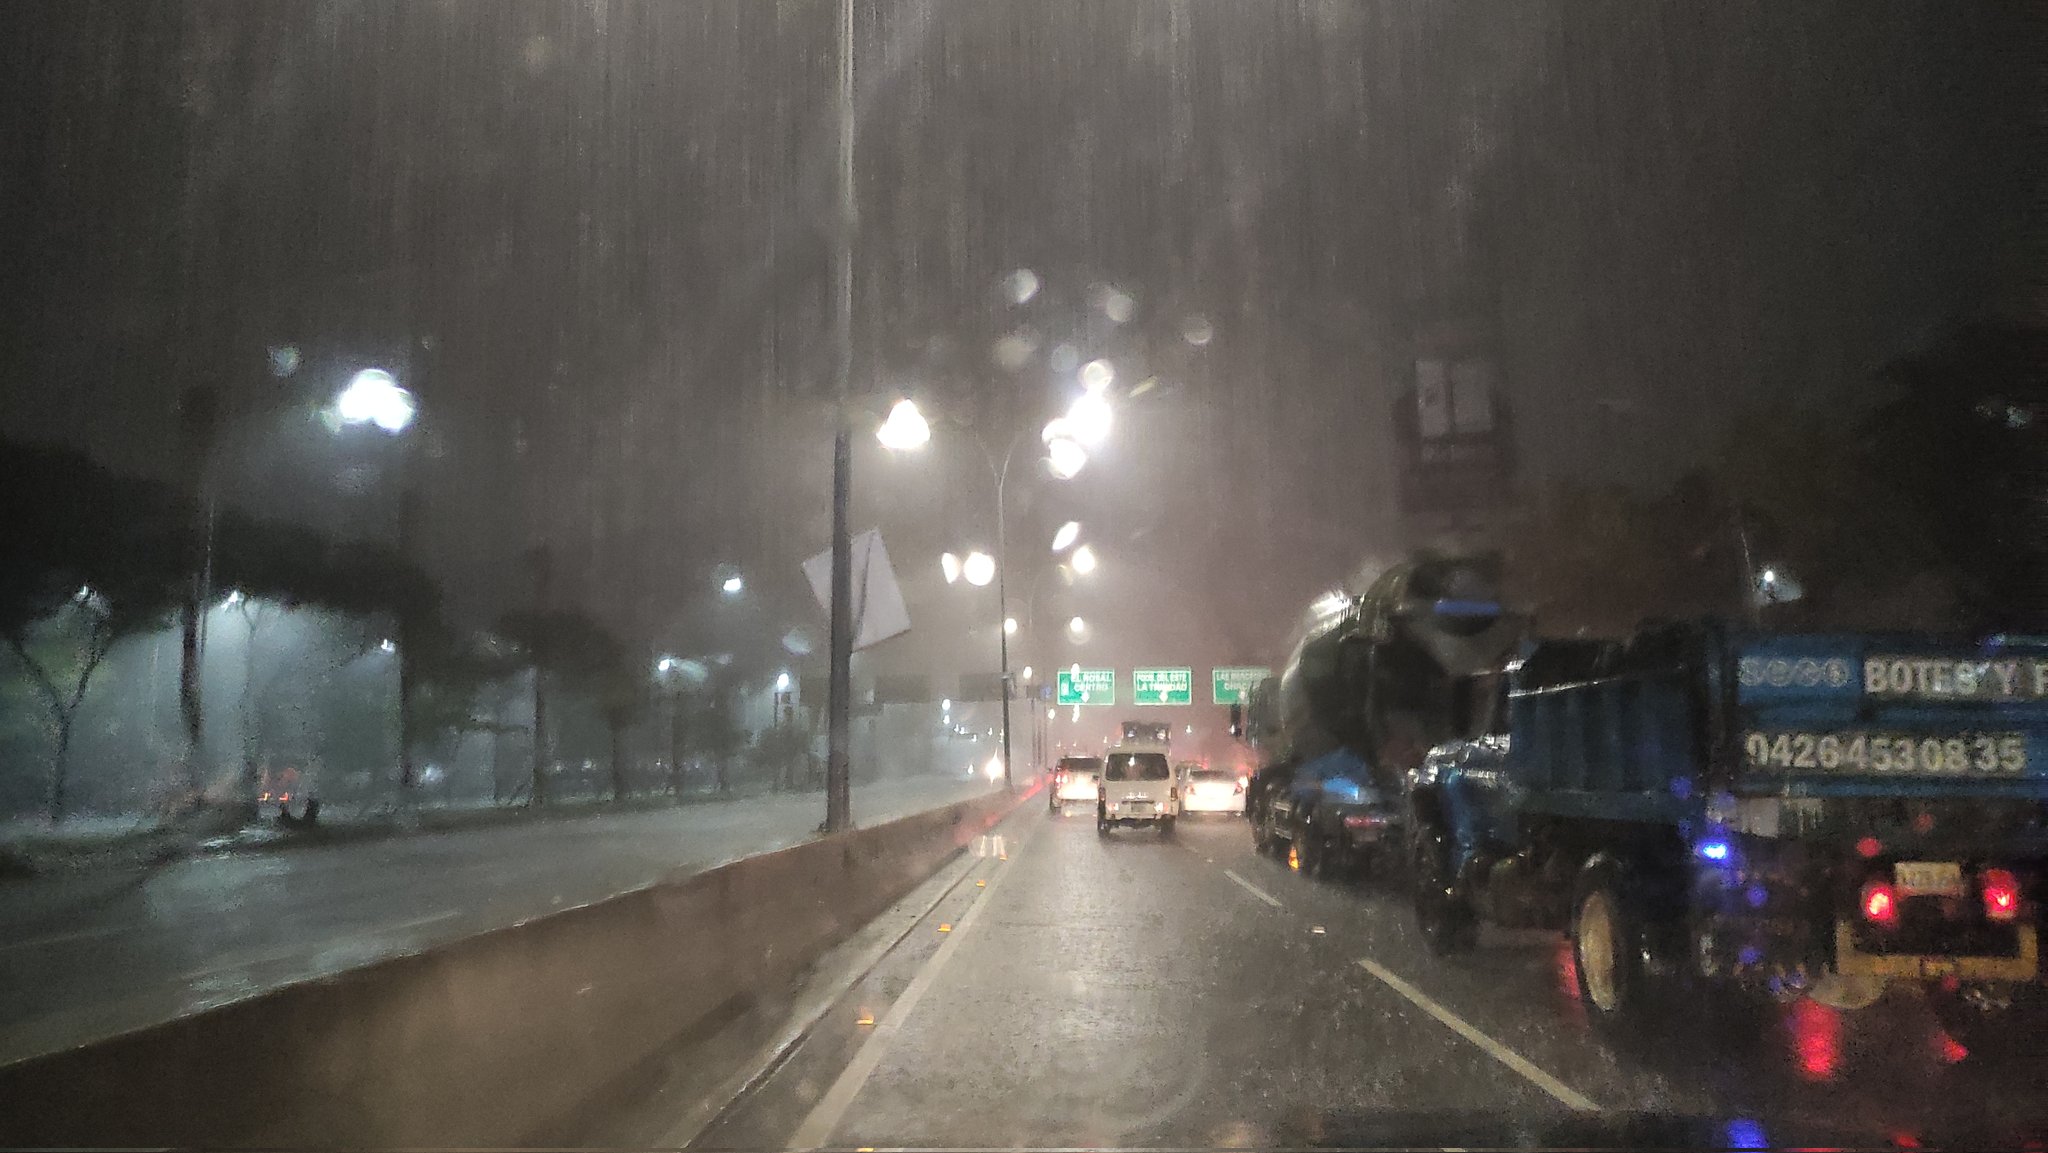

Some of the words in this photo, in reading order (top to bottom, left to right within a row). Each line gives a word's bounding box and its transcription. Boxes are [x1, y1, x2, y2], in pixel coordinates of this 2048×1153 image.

[1083, 672, 1112, 682] ROSAL
[1074, 682, 1109, 691] CENTRO
[1137, 682, 1147, 691] LA
